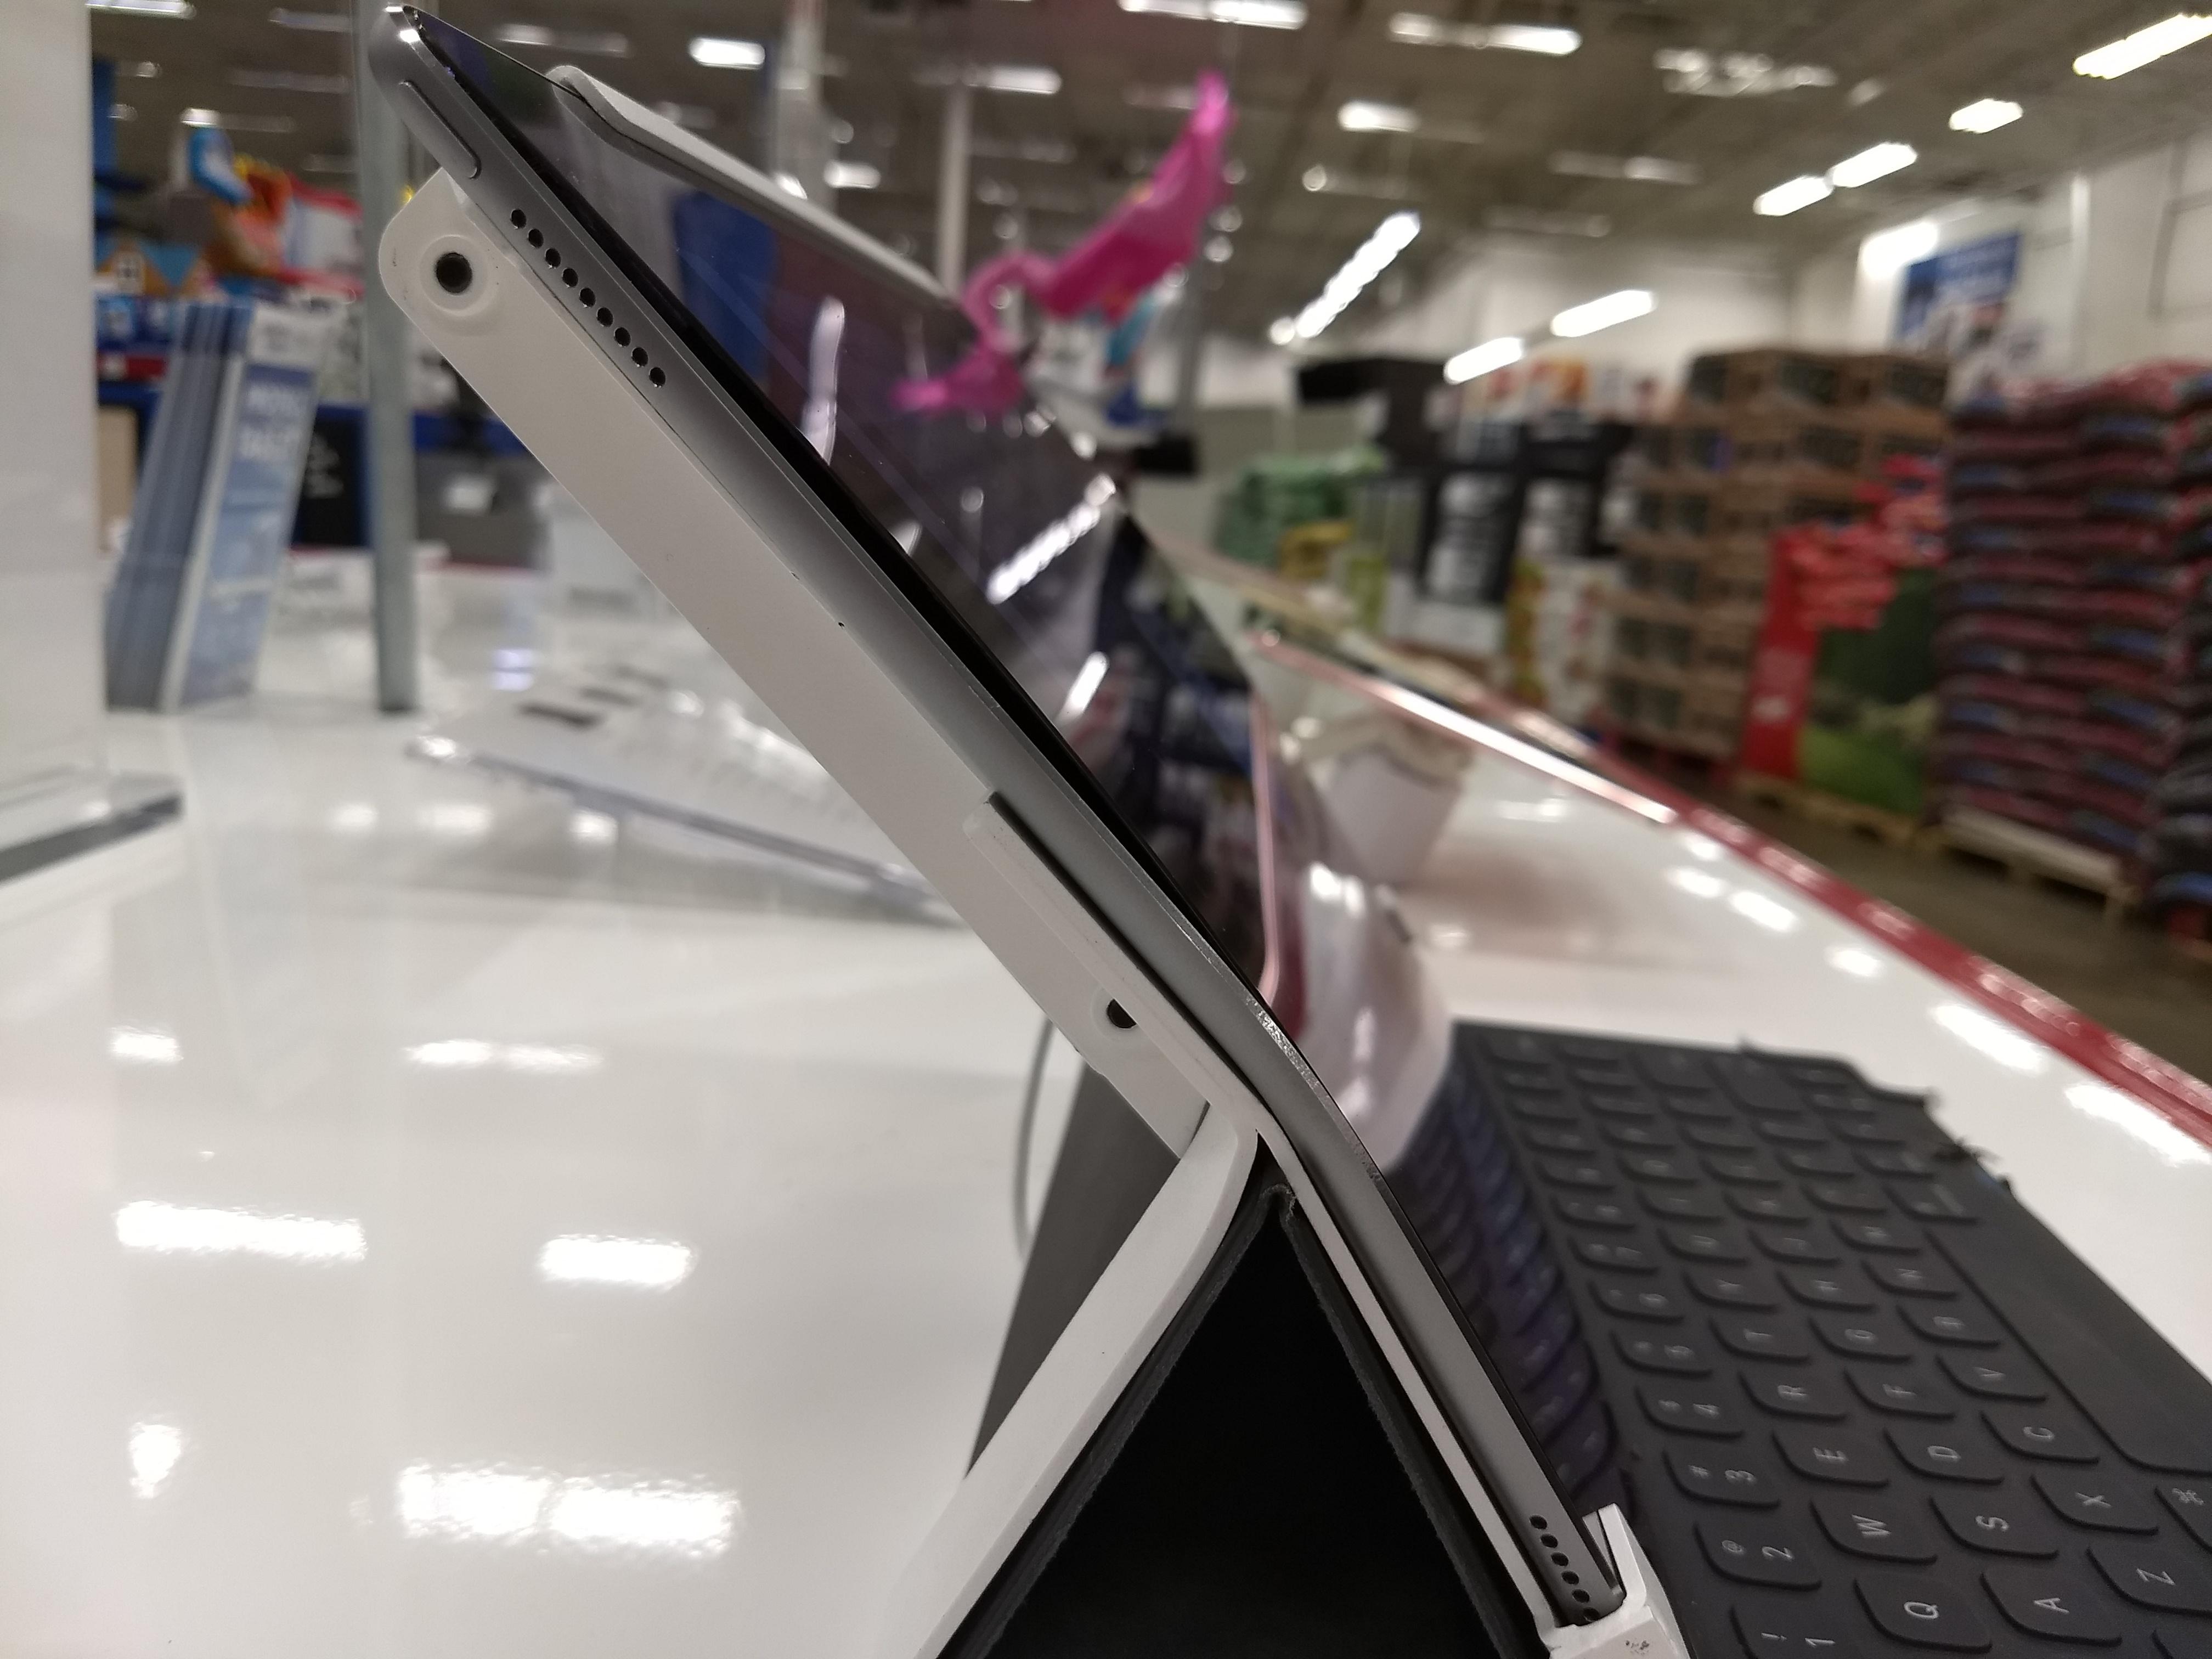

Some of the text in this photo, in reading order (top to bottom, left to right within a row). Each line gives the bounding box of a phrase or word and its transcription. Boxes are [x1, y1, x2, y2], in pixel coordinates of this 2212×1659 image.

[1974, 1367, 2007, 1379] V
[2023, 1426, 2055, 1441] C
[1813, 1447, 1848, 1463] E
[1927, 1446, 1961, 1462] D
[1725, 1470, 1756, 1482] 3
[2075, 1492, 2112, 1509] X
[1852, 1514, 1892, 1537] W
[1975, 1515, 2009, 1532] S
[1762, 1546, 1793, 1560] 2
[2136, 1567, 2175, 1585] Z
[1904, 1601, 1939, 1620] Q
[2033, 1597, 2070, 1614] A
